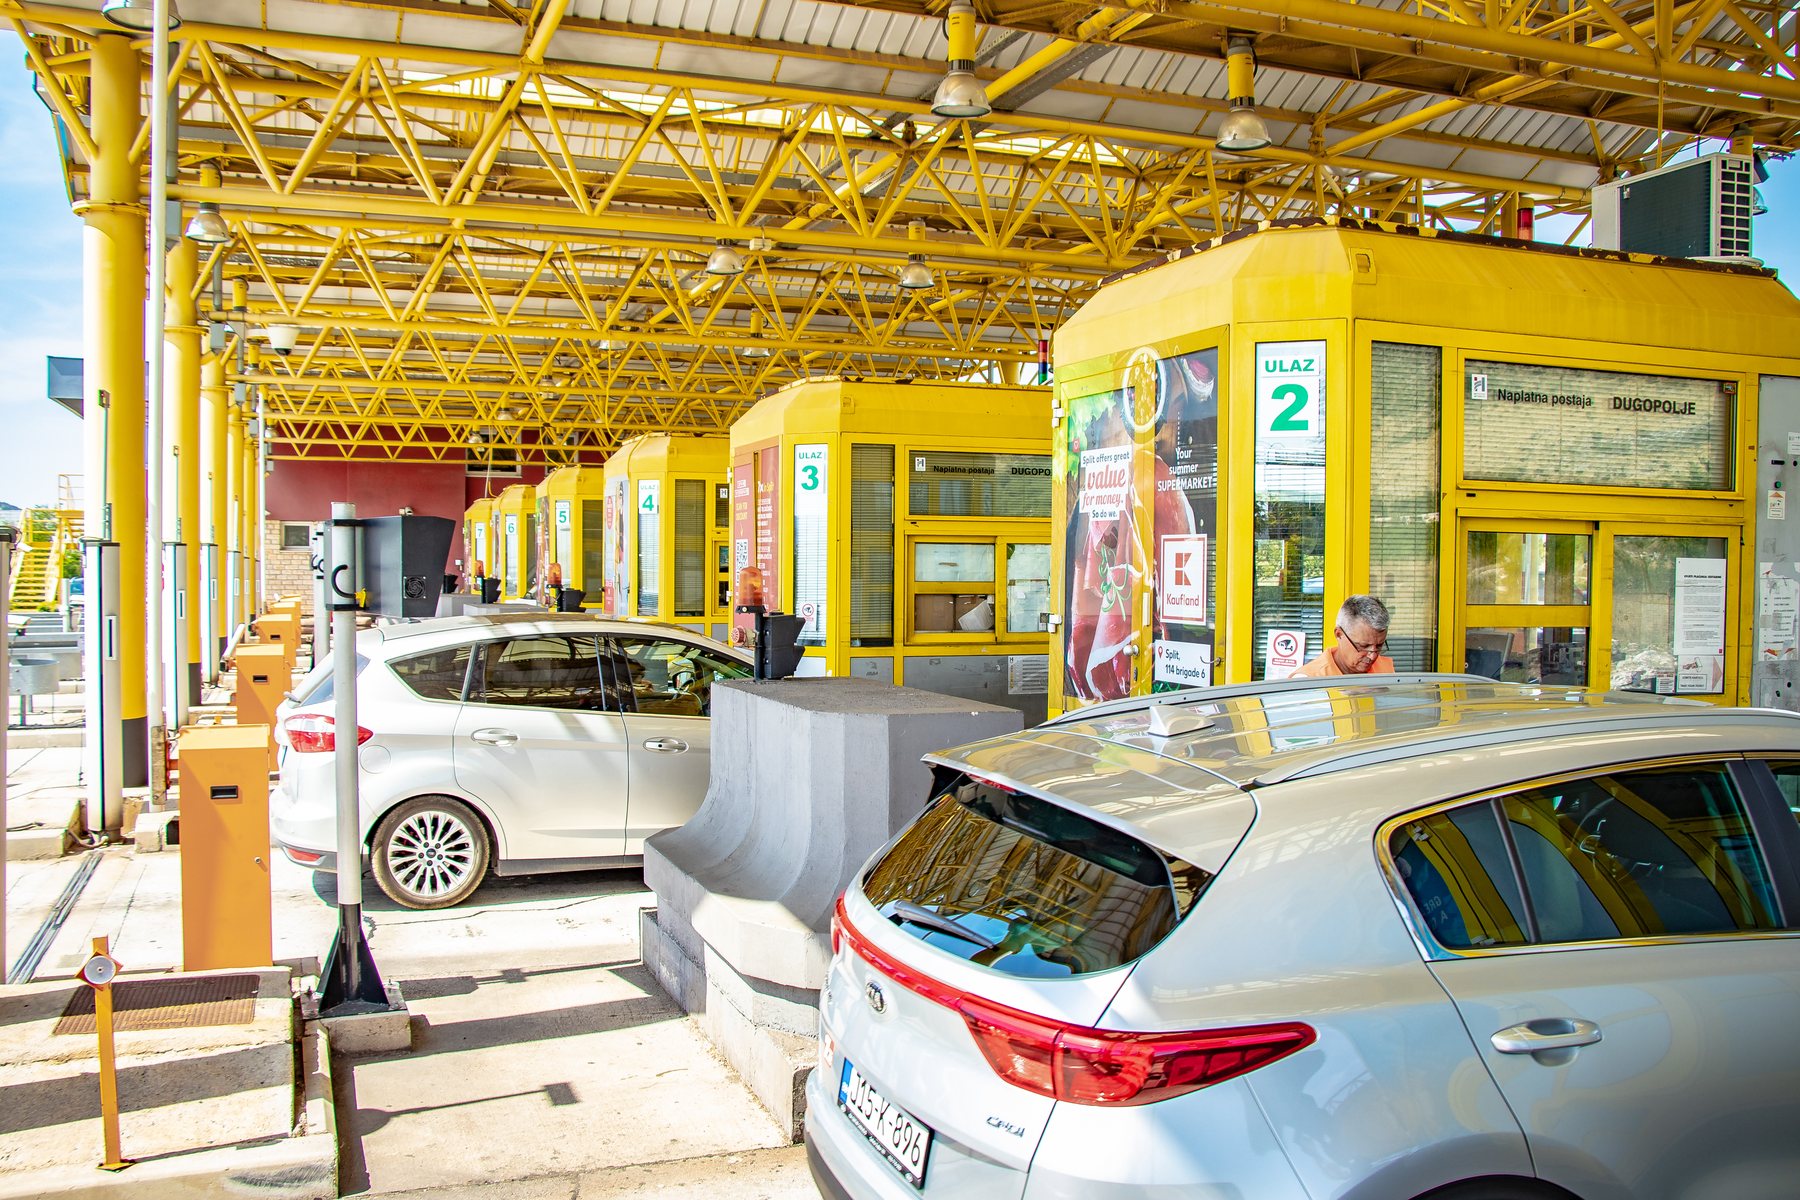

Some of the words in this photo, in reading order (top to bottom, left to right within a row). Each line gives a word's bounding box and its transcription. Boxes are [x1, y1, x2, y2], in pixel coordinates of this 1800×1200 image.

[1265, 359, 1315, 373] ULAZ
[1270, 383, 1309, 432] 2
[1498, 389, 1548, 405] Naplatna
[1551, 393, 1592, 409] postaja
[1613, 396, 1696, 415] DUGOPOLJE
[798, 451, 823, 460] ULAZ
[1082, 455, 1095, 466] Split
[1096, 453, 1112, 463] offers
[1114, 451, 1130, 463] great
[1175, 447, 1192, 460] Your
[933, 465, 966, 474] Naplatna
[968, 465, 995, 475] postaja
[1011, 467, 1051, 476] DUGOPO
[1169, 463, 1199, 475] summer
[801, 465, 819, 491] 3
[1087, 464, 1127, 490] value
[1157, 476, 1213, 492] SUPERMARKET
[642, 494, 654, 511] 4
[1081, 492, 1095, 511] for
[558, 510, 567, 524] 5
[1092, 509, 1099, 518] So
[1100, 509, 1107, 518] do
[477, 528, 483, 538] 7
[508, 522, 515, 533] 6
[1166, 593, 1200, 607] Kaufland
[1165, 664, 1175, 674] 114
[1175, 665, 1200, 679] brigade
[1200, 668, 1206, 679] 6
[850, 1072, 921, 1167] J15-K-896
